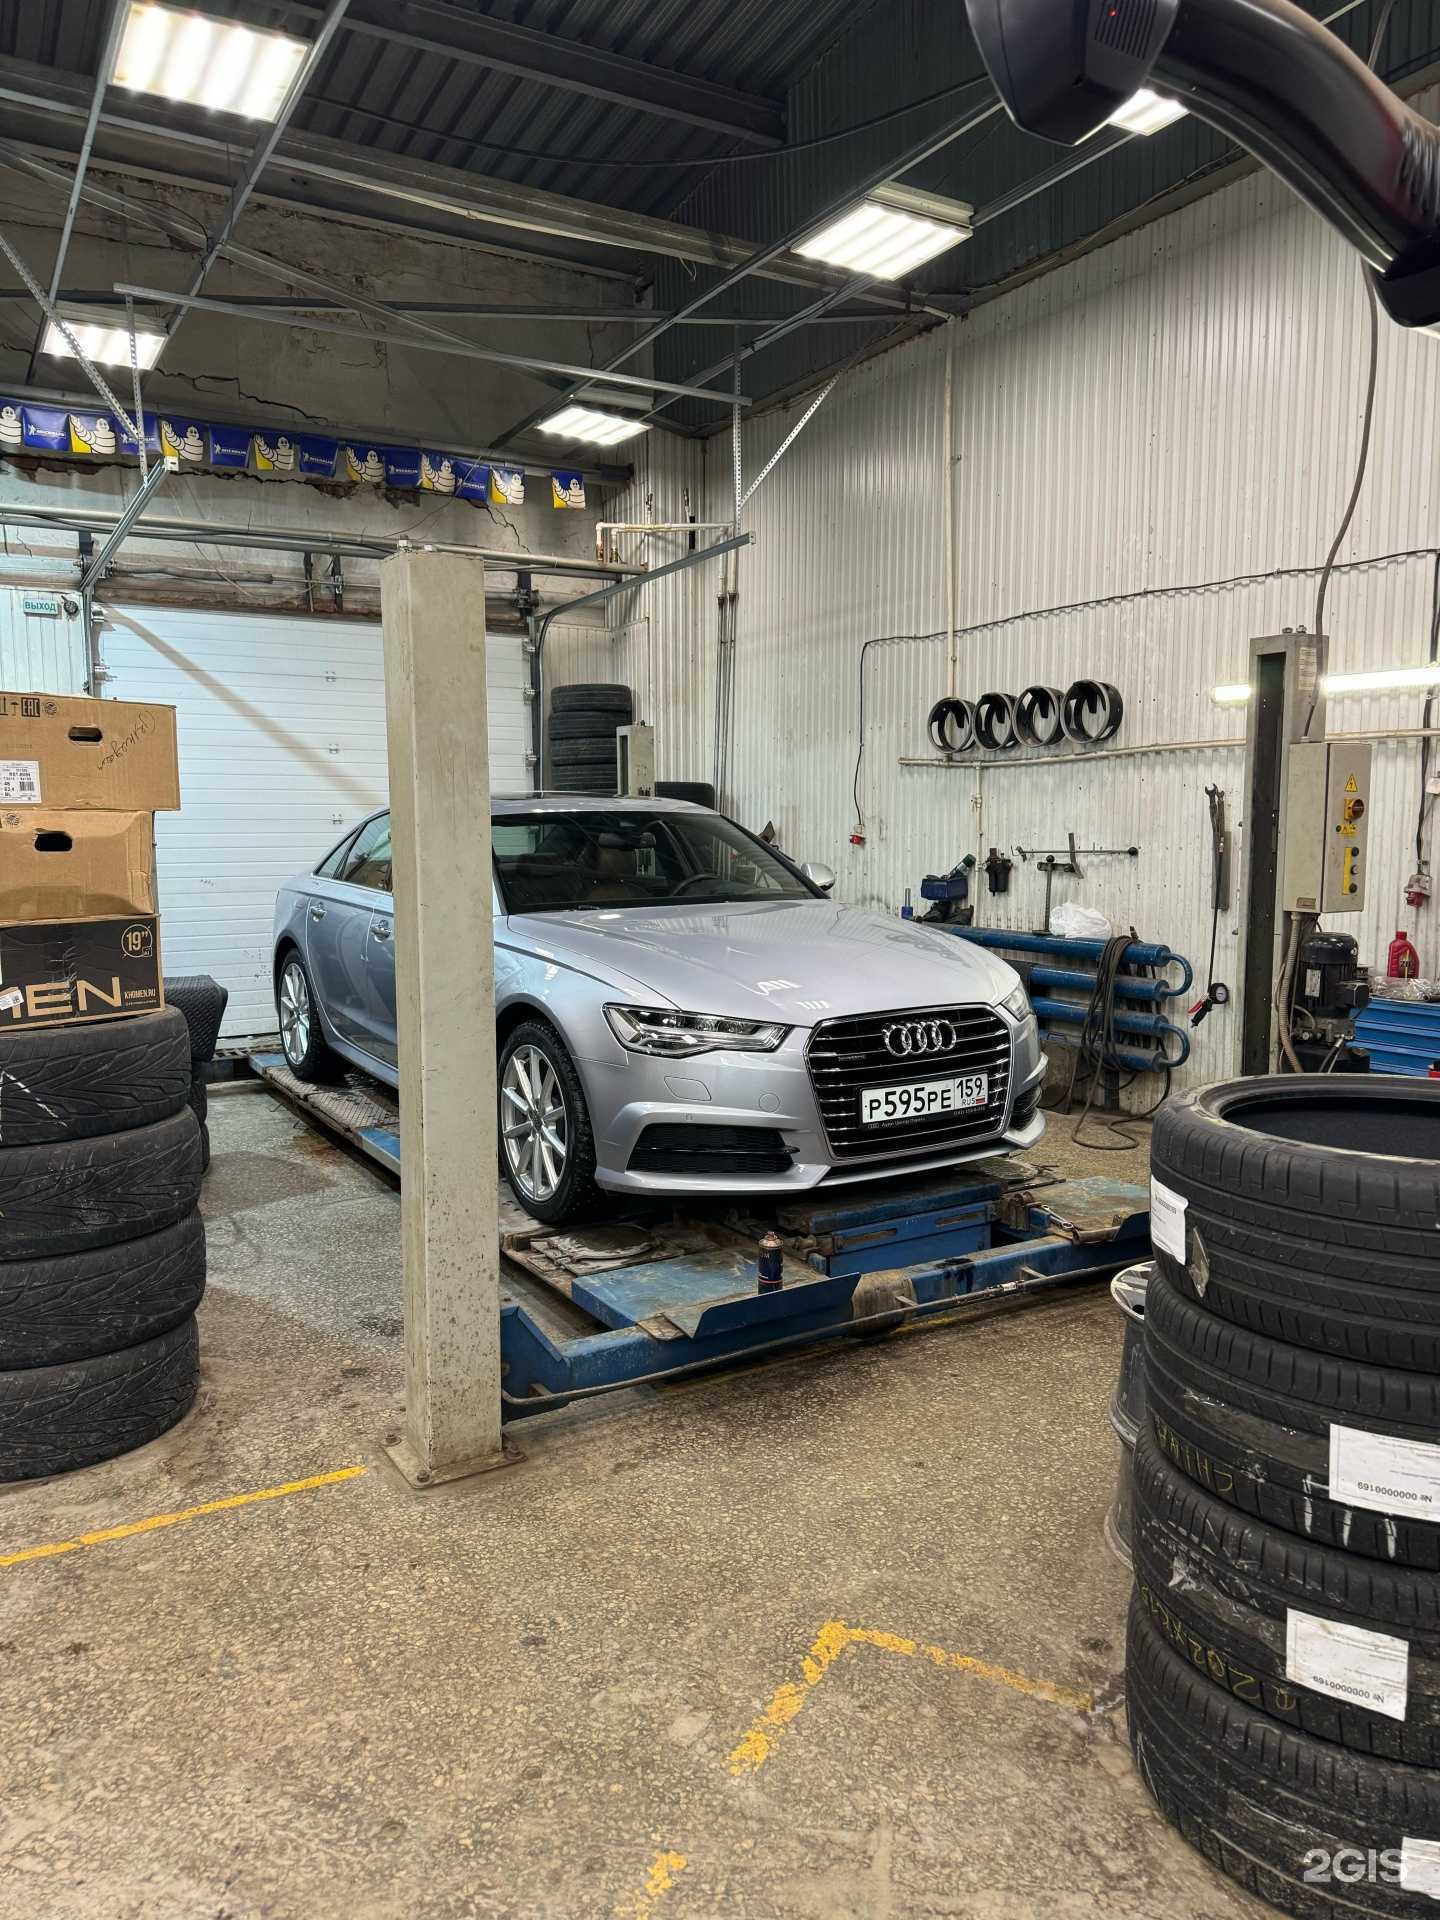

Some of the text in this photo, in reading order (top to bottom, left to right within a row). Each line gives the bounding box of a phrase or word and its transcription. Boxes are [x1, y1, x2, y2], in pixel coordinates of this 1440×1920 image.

[24, 600, 56, 612] ВЫХОД
[956, 1077, 983, 1098] 159
[961, 1098, 976, 1106] RUS
